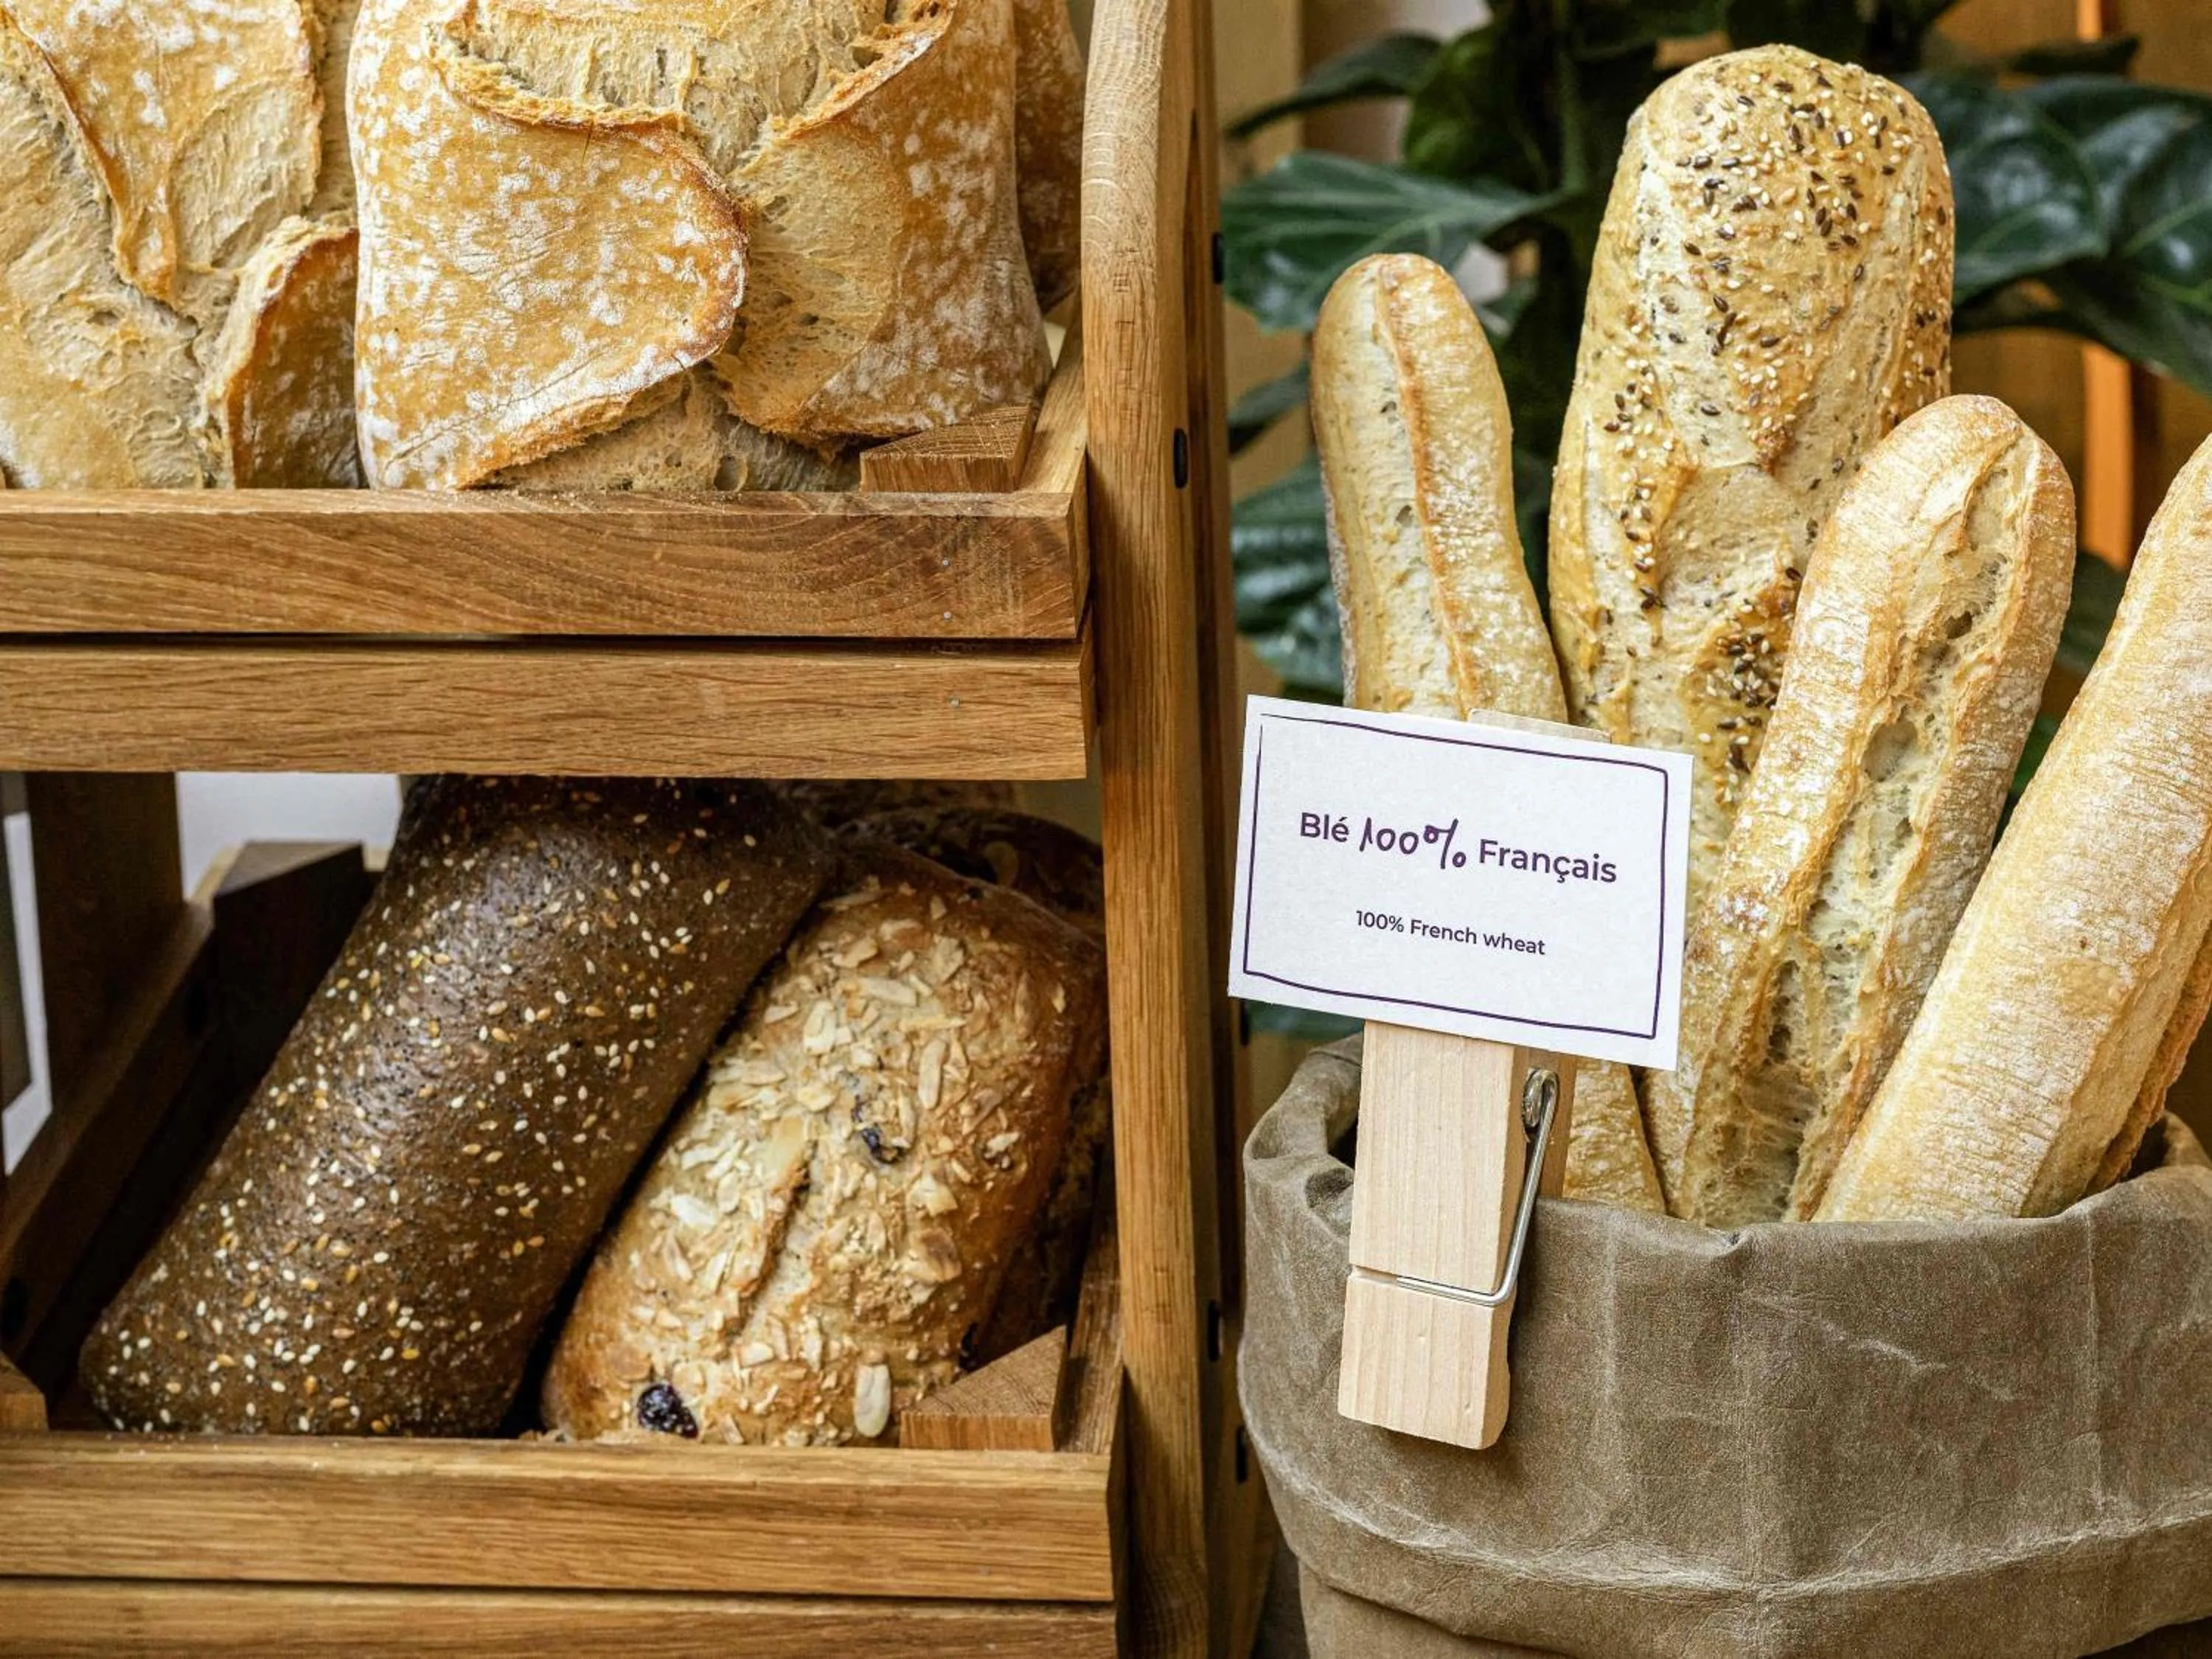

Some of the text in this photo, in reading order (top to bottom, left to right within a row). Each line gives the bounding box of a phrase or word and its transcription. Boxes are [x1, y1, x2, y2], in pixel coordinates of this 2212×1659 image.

[1301, 813, 1616, 883] Blé 100% Français
[1357, 911, 1545, 955] 100% French wheat
